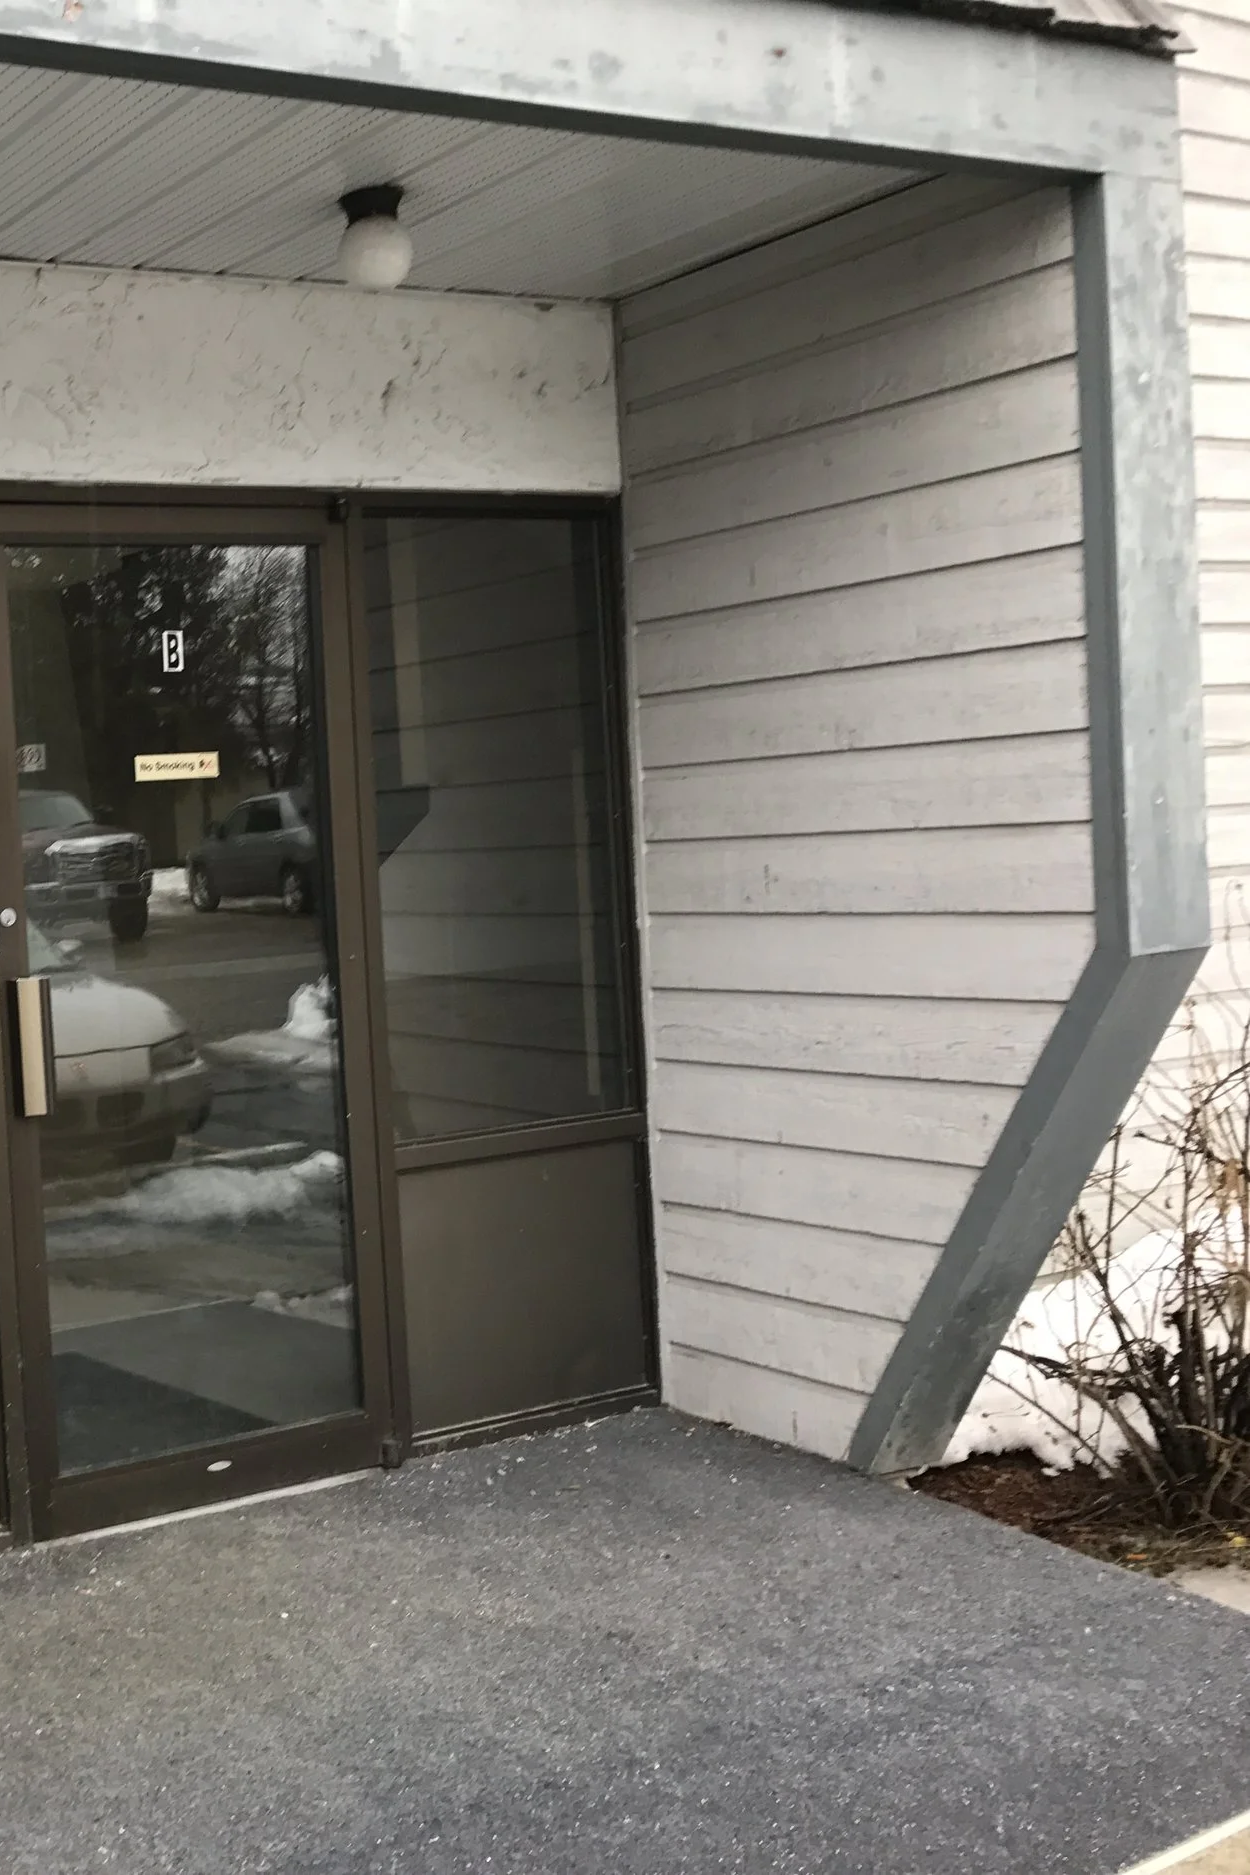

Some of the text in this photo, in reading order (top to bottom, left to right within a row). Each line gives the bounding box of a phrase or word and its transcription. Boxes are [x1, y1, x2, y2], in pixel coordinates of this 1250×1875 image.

[166, 633, 180, 669] B
[139, 760, 195, 773] No Smoking
